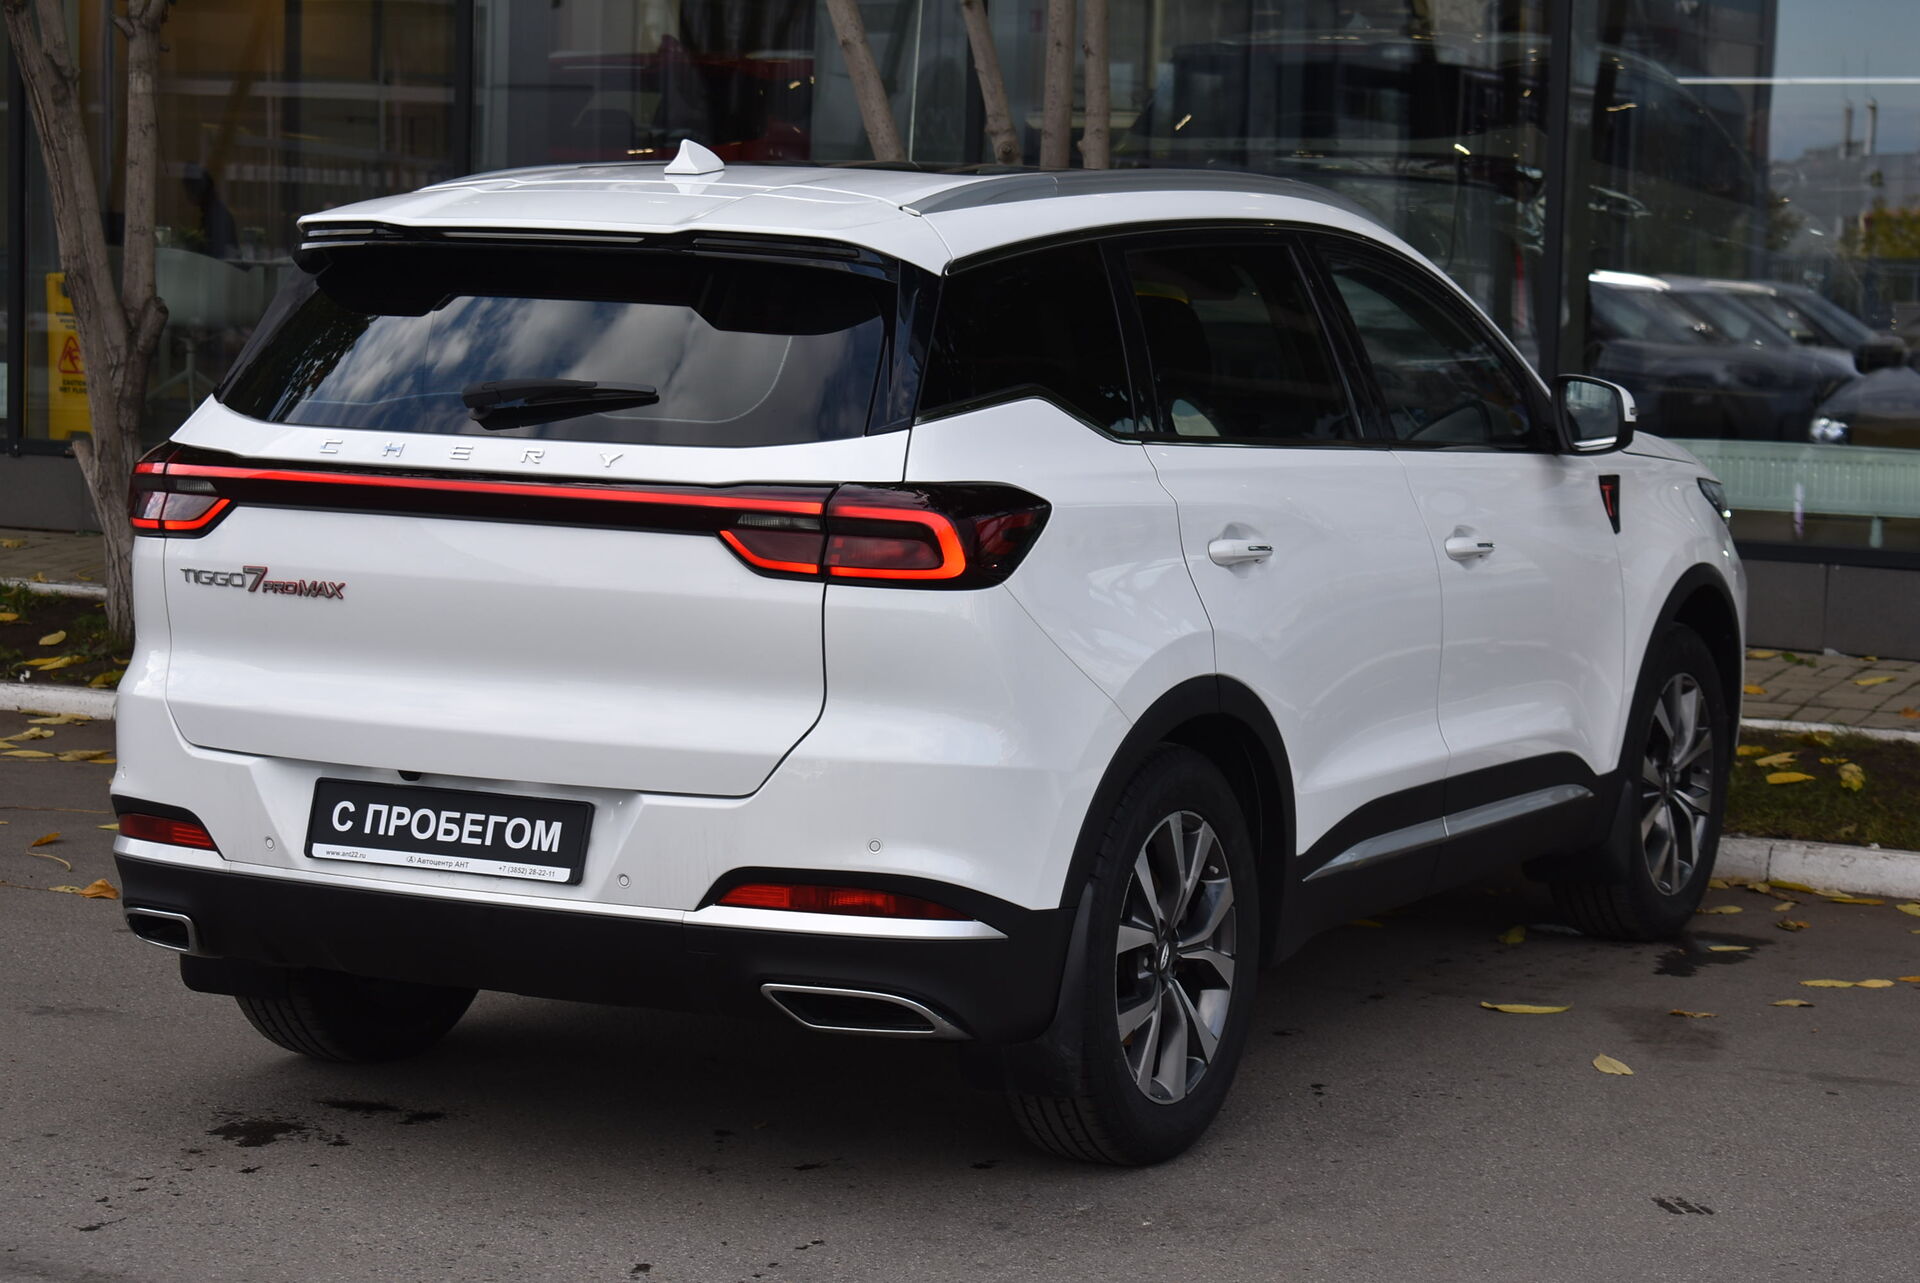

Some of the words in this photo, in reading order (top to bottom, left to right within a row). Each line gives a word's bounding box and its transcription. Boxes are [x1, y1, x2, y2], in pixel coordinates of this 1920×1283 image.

[319, 438, 625, 468] CHERY
[331, 800, 356, 832] С
[363, 803, 563, 853] ПРОБЕГОМ
[325, 849, 367, 860] www.ant22.ru
[416, 857, 453, 868] Автоцентр
[498, 865, 507, 873] +7
[507, 866, 528, 876] (3852)
[528, 868, 556, 877] 28-22-11
